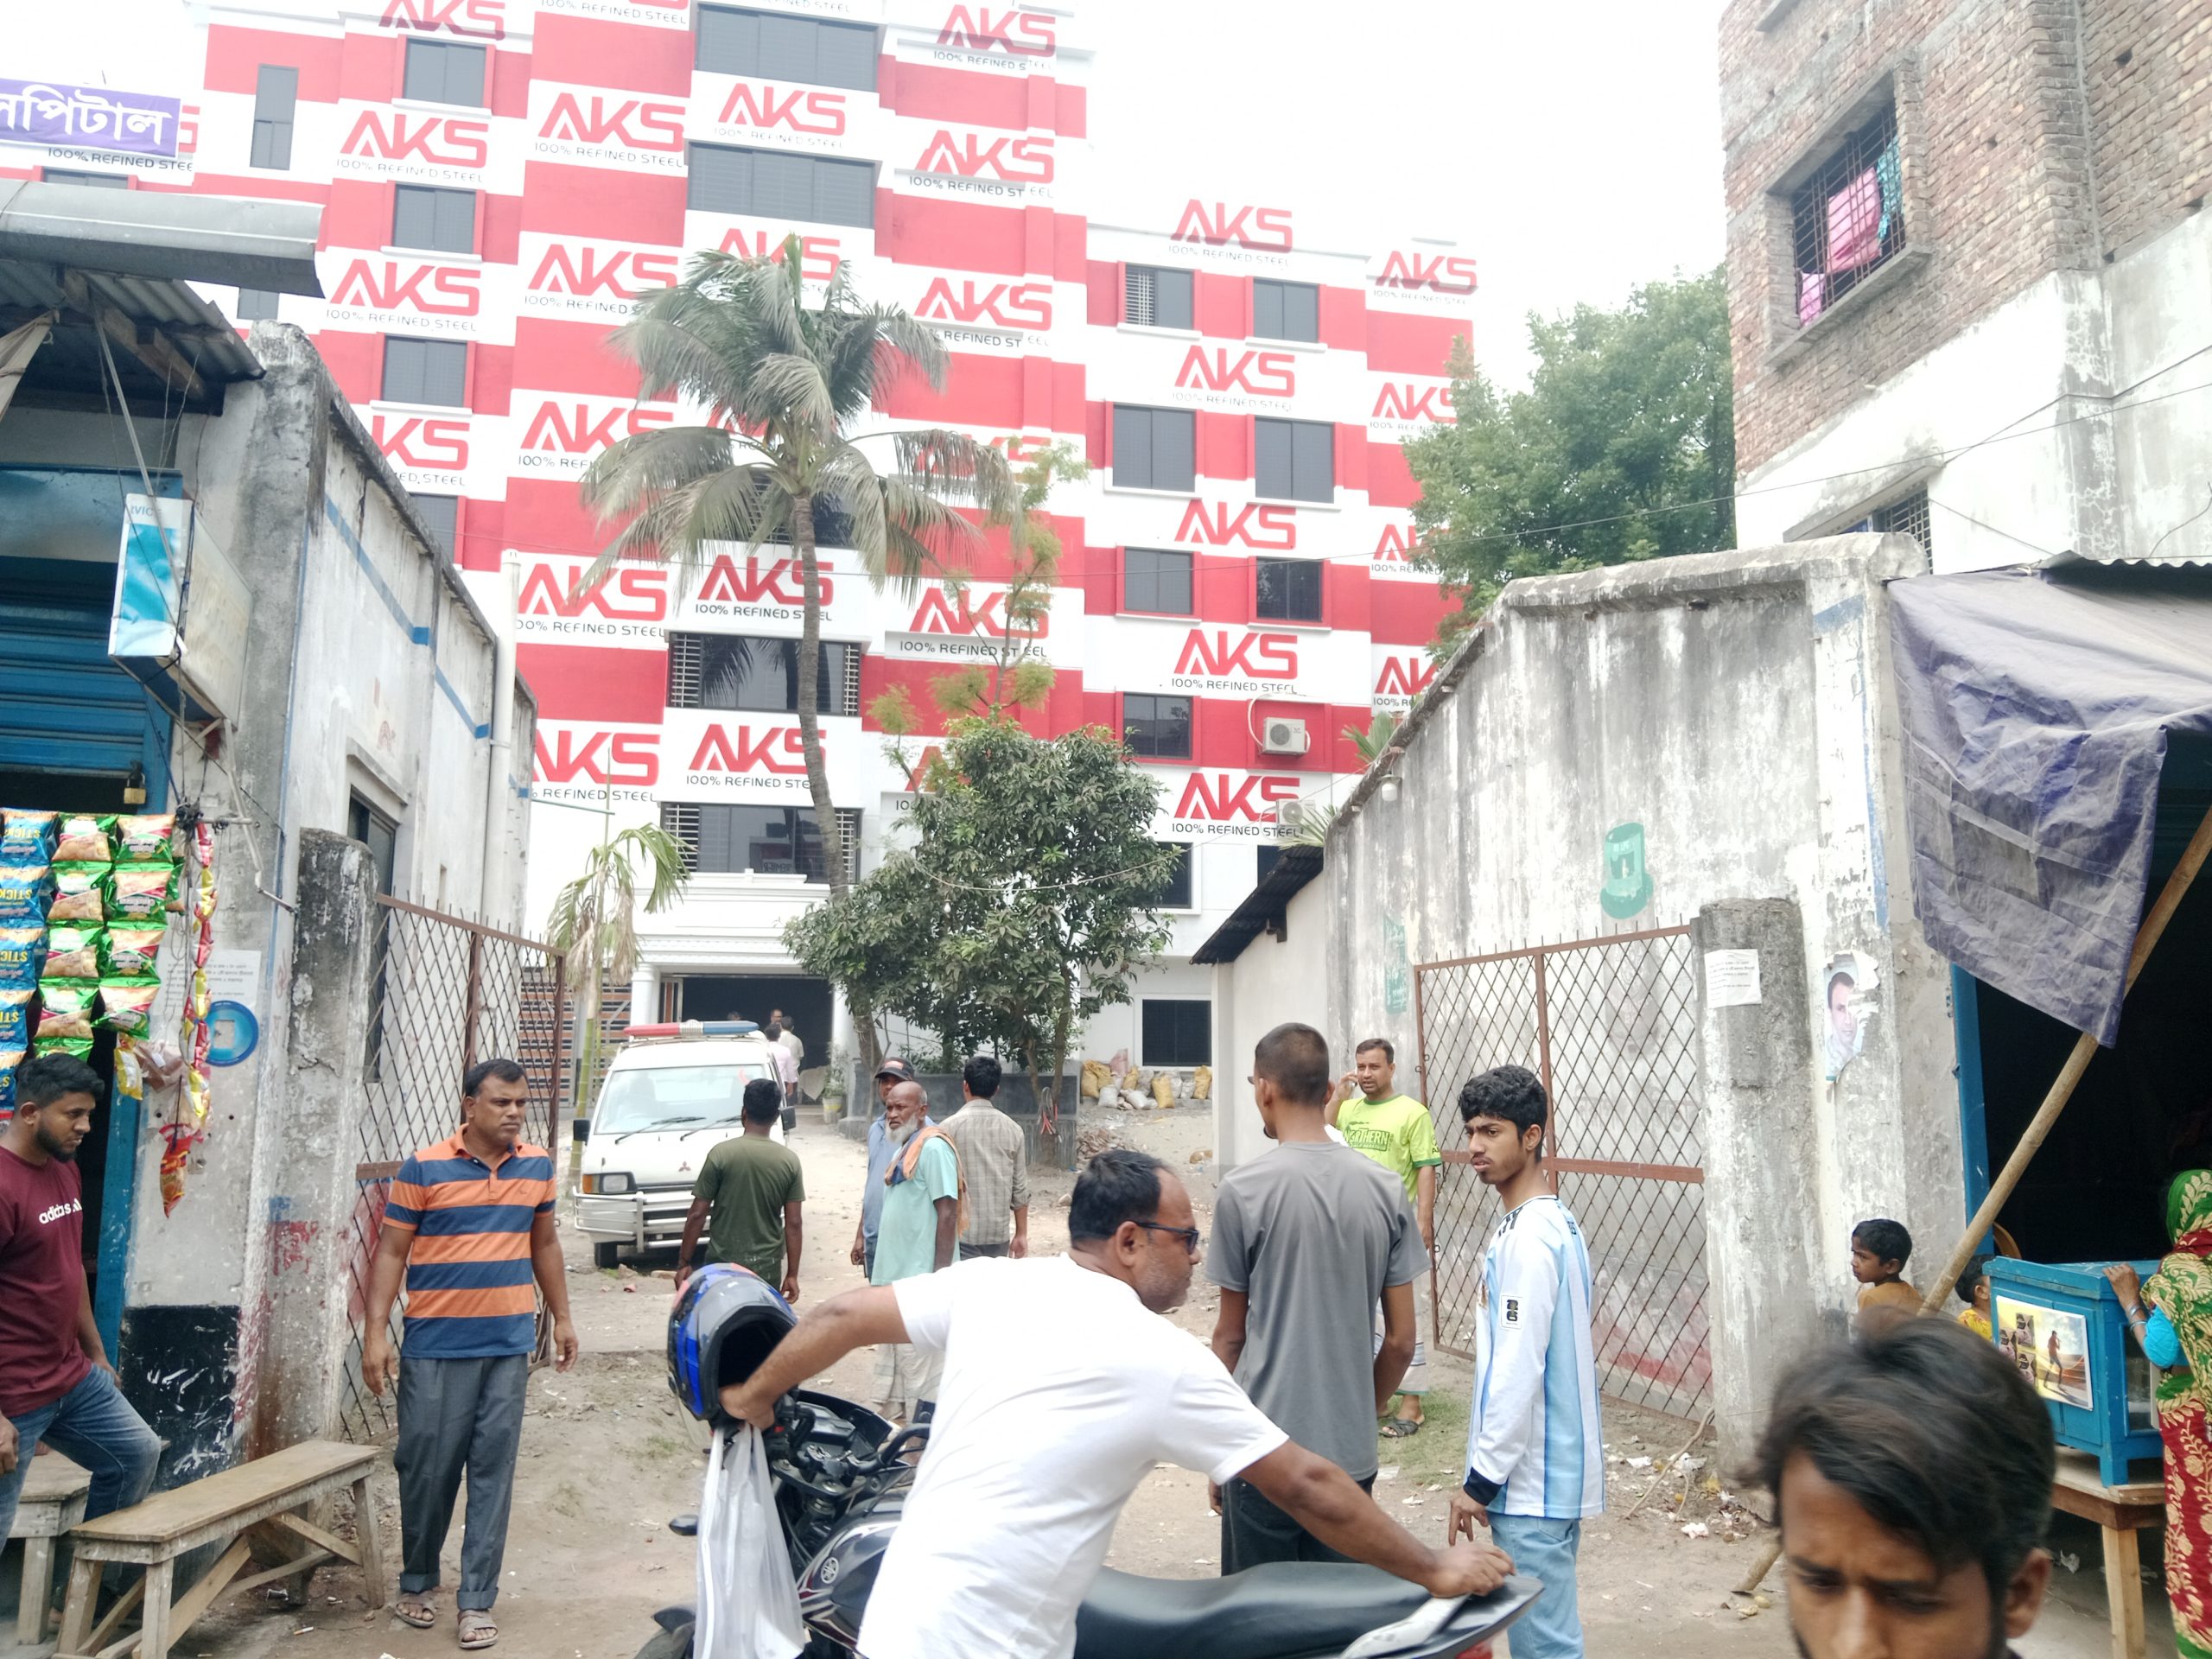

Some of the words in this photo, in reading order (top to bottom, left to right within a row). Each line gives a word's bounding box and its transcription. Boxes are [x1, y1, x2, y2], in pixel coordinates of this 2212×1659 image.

[378, 0, 505, 41] AKS
[582, 3, 640, 18] REFINED
[645, 10, 687, 24] STEEL
[936, 4, 1057, 58] AKS
[933, 51, 963, 63] 100%
[967, 56, 1015, 70] REFINED
[718, 82, 846, 137] AKS
[538, 92, 686, 153] AKS
[340, 110, 489, 168] AKS
[91, 153, 155, 169] REFINED
[535, 142, 572, 156] 100%
[576, 147, 637, 162] REFINED
[641, 154, 683, 168] STEEL
[914, 130, 1054, 184] AKS
[336, 158, 373, 171] 100%
[378, 163, 438, 178] REFINED
[442, 170, 483, 183] STEEL
[909, 176, 944, 189] 100%
[948, 181, 1004, 196] REFINED
[1170, 199, 1293, 254] AKS
[1203, 249, 1252, 263] REFINED
[1256, 255, 1289, 267] STEEL
[1376, 251, 1478, 296] AKS
[329, 258, 481, 316] AKS
[524, 296, 562, 308] 100%
[567, 299, 627, 314] REFINED
[914, 276, 1052, 331] AKS
[326, 309, 364, 321] 100%
[369, 313, 429, 327] REFINED
[435, 319, 477, 332] STEEL
[944, 331, 1001, 346] REFINED
[1174, 345, 1295, 397] AKS
[1206, 395, 1256, 408] REFINED
[372, 415, 470, 471] KS
[518, 455, 556, 467] 100%
[423, 474, 466, 486] STEEL
[1174, 498, 1296, 550] AKS
[1371, 563, 1396, 572] 100%
[518, 563, 667, 621] AKS
[697, 555, 834, 607] AKS
[696, 604, 728, 614] 100%
[734, 607, 789, 620] REFINED
[908, 587, 1051, 639] AKS
[518, 620, 548, 632] 00%
[553, 621, 616, 635] REFINED
[621, 626, 664, 638] STEEL
[900, 641, 935, 652] 100%
[939, 643, 997, 657] REFINED
[1174, 629, 1298, 680] AKS
[1172, 678, 1203, 689] 100%
[1207, 681, 1258, 692] REFINED
[1375, 656, 1439, 696] AK
[1373, 697, 1399, 707] 100%
[689, 723, 827, 774] AKS
[686, 775, 721, 785] 100%
[725, 777, 781, 788] REFINED
[785, 779, 810, 790] STE
[543, 788, 607, 800] REFINED
[612, 791, 658, 803] STEEL
[1174, 772, 1300, 823] AKS
[1172, 823, 1204, 834] 100%
[1208, 824, 1260, 836] REFINED
